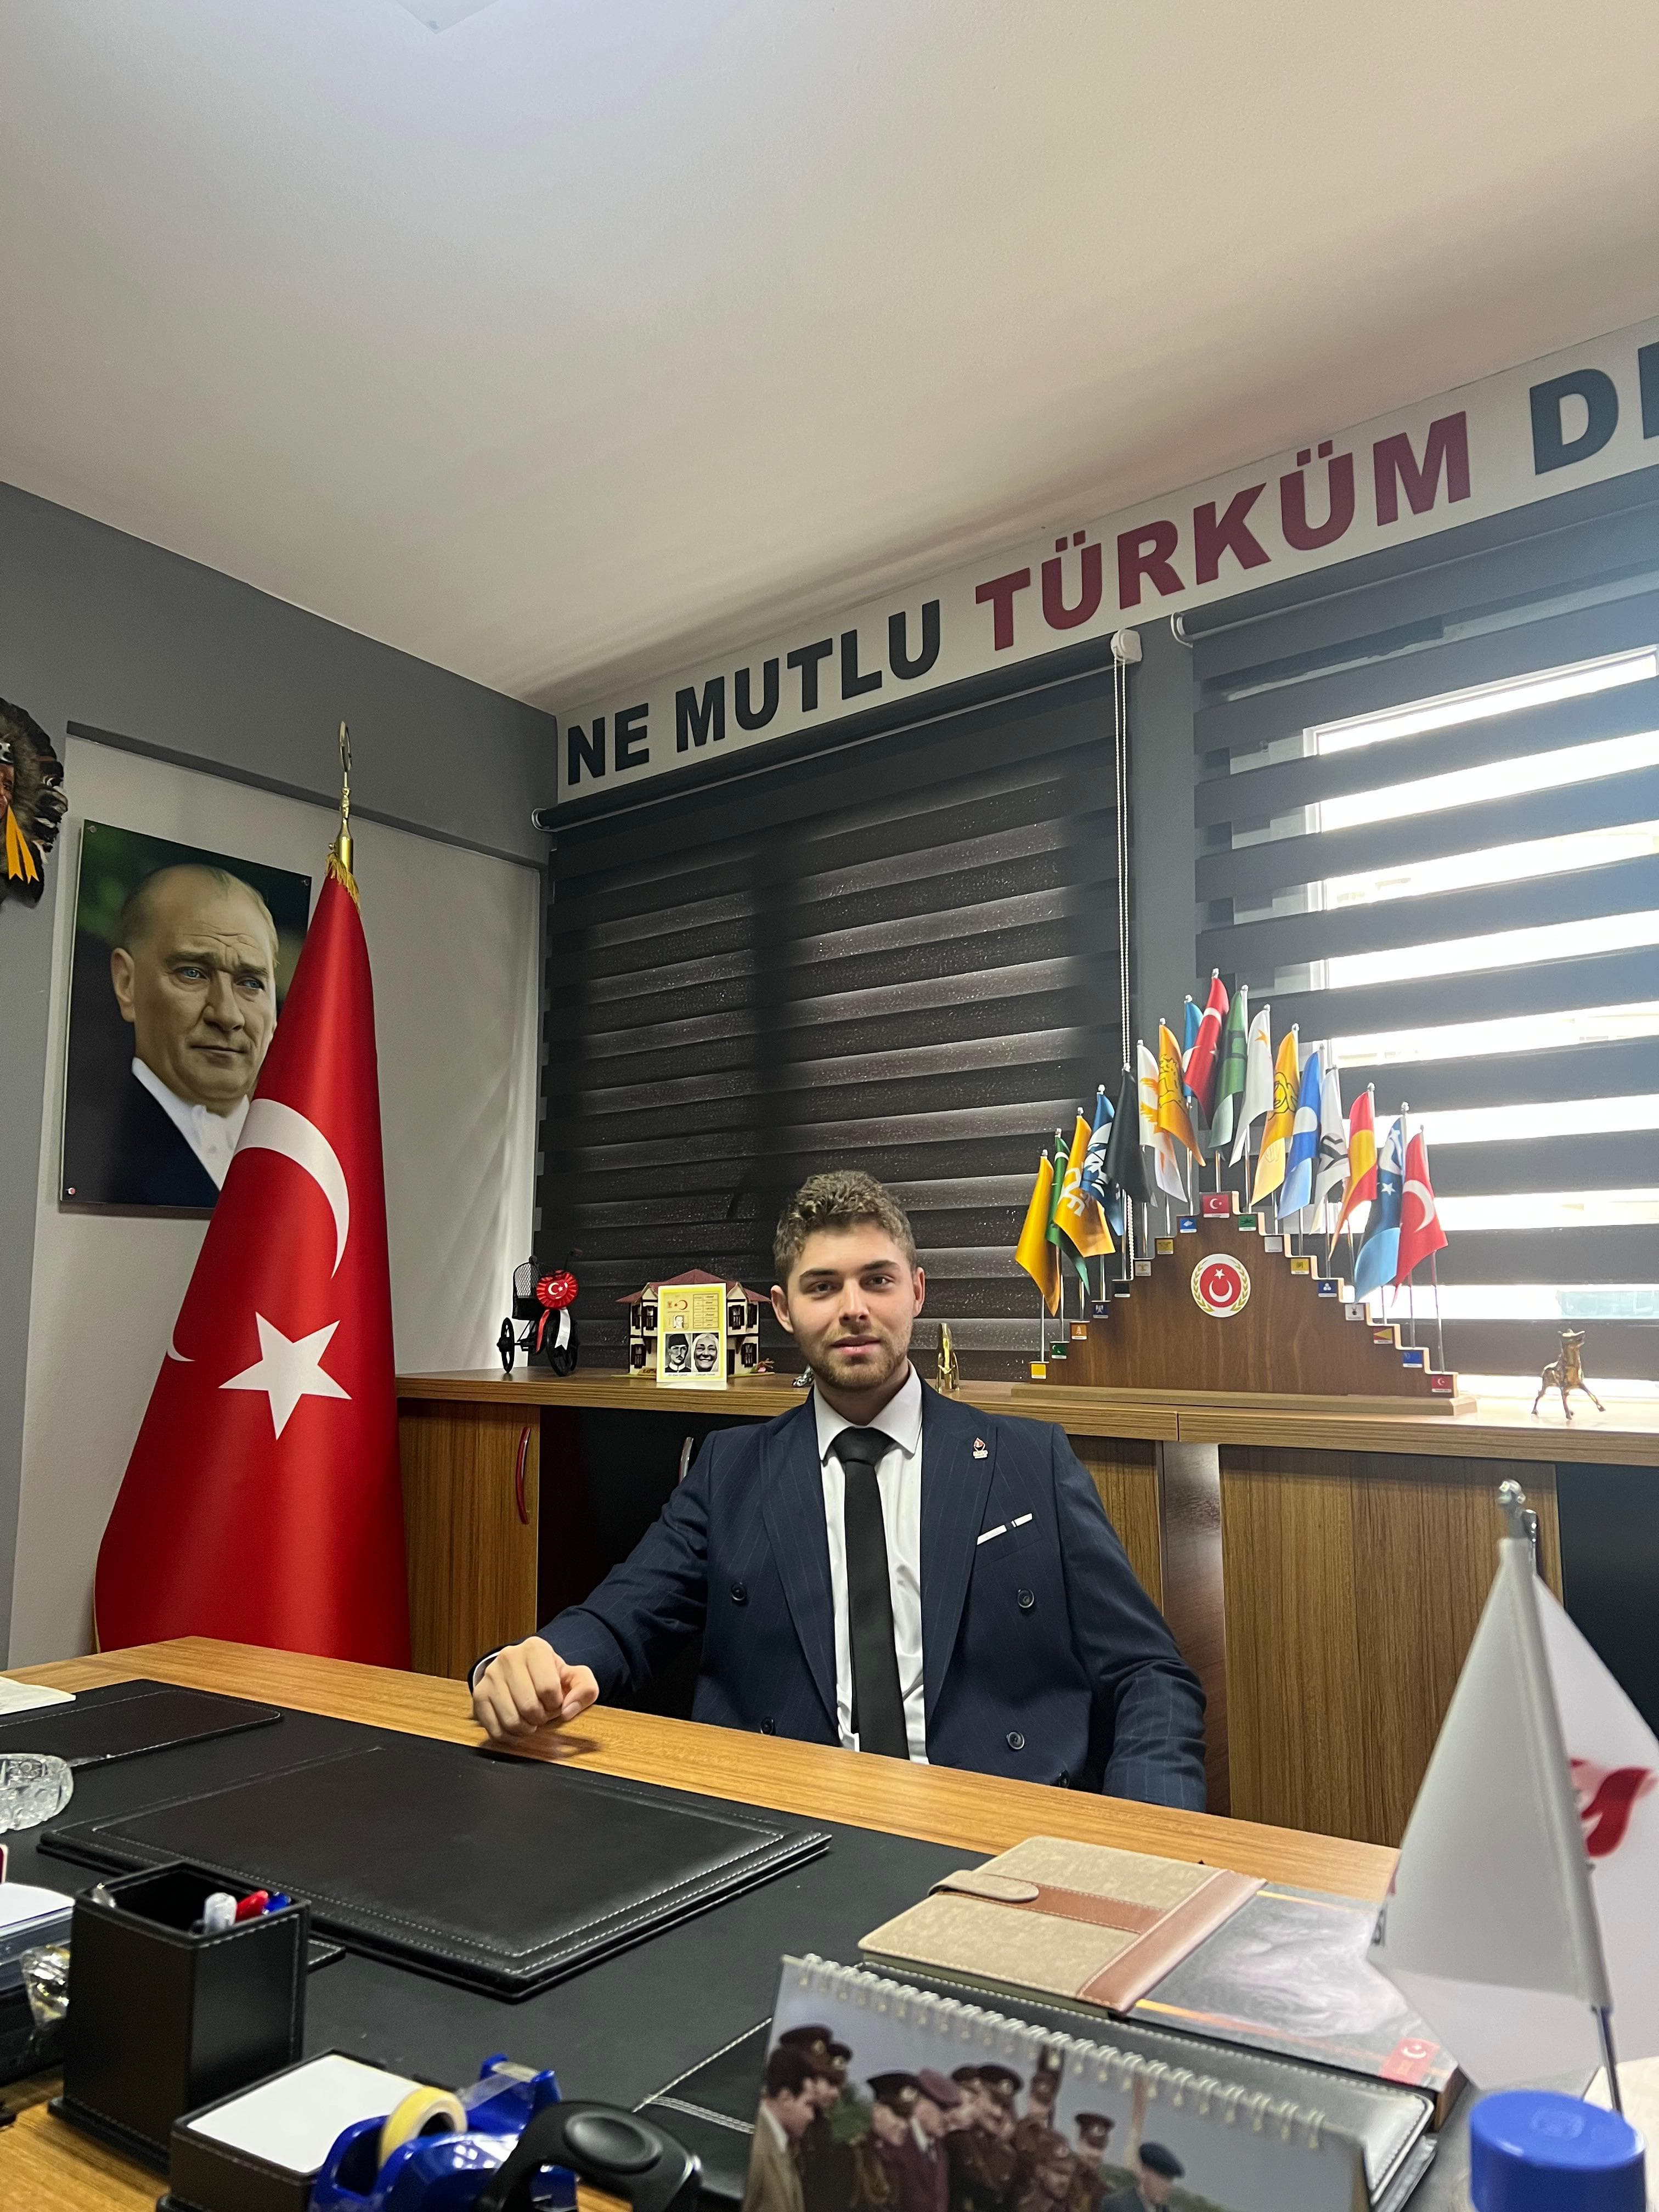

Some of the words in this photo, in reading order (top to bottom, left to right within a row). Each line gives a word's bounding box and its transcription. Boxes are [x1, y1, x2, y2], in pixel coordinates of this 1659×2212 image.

[568, 702, 650, 786] NE
[675, 599, 941, 754] MUTLU
[975, 410, 1471, 652] TÜRKÜM
